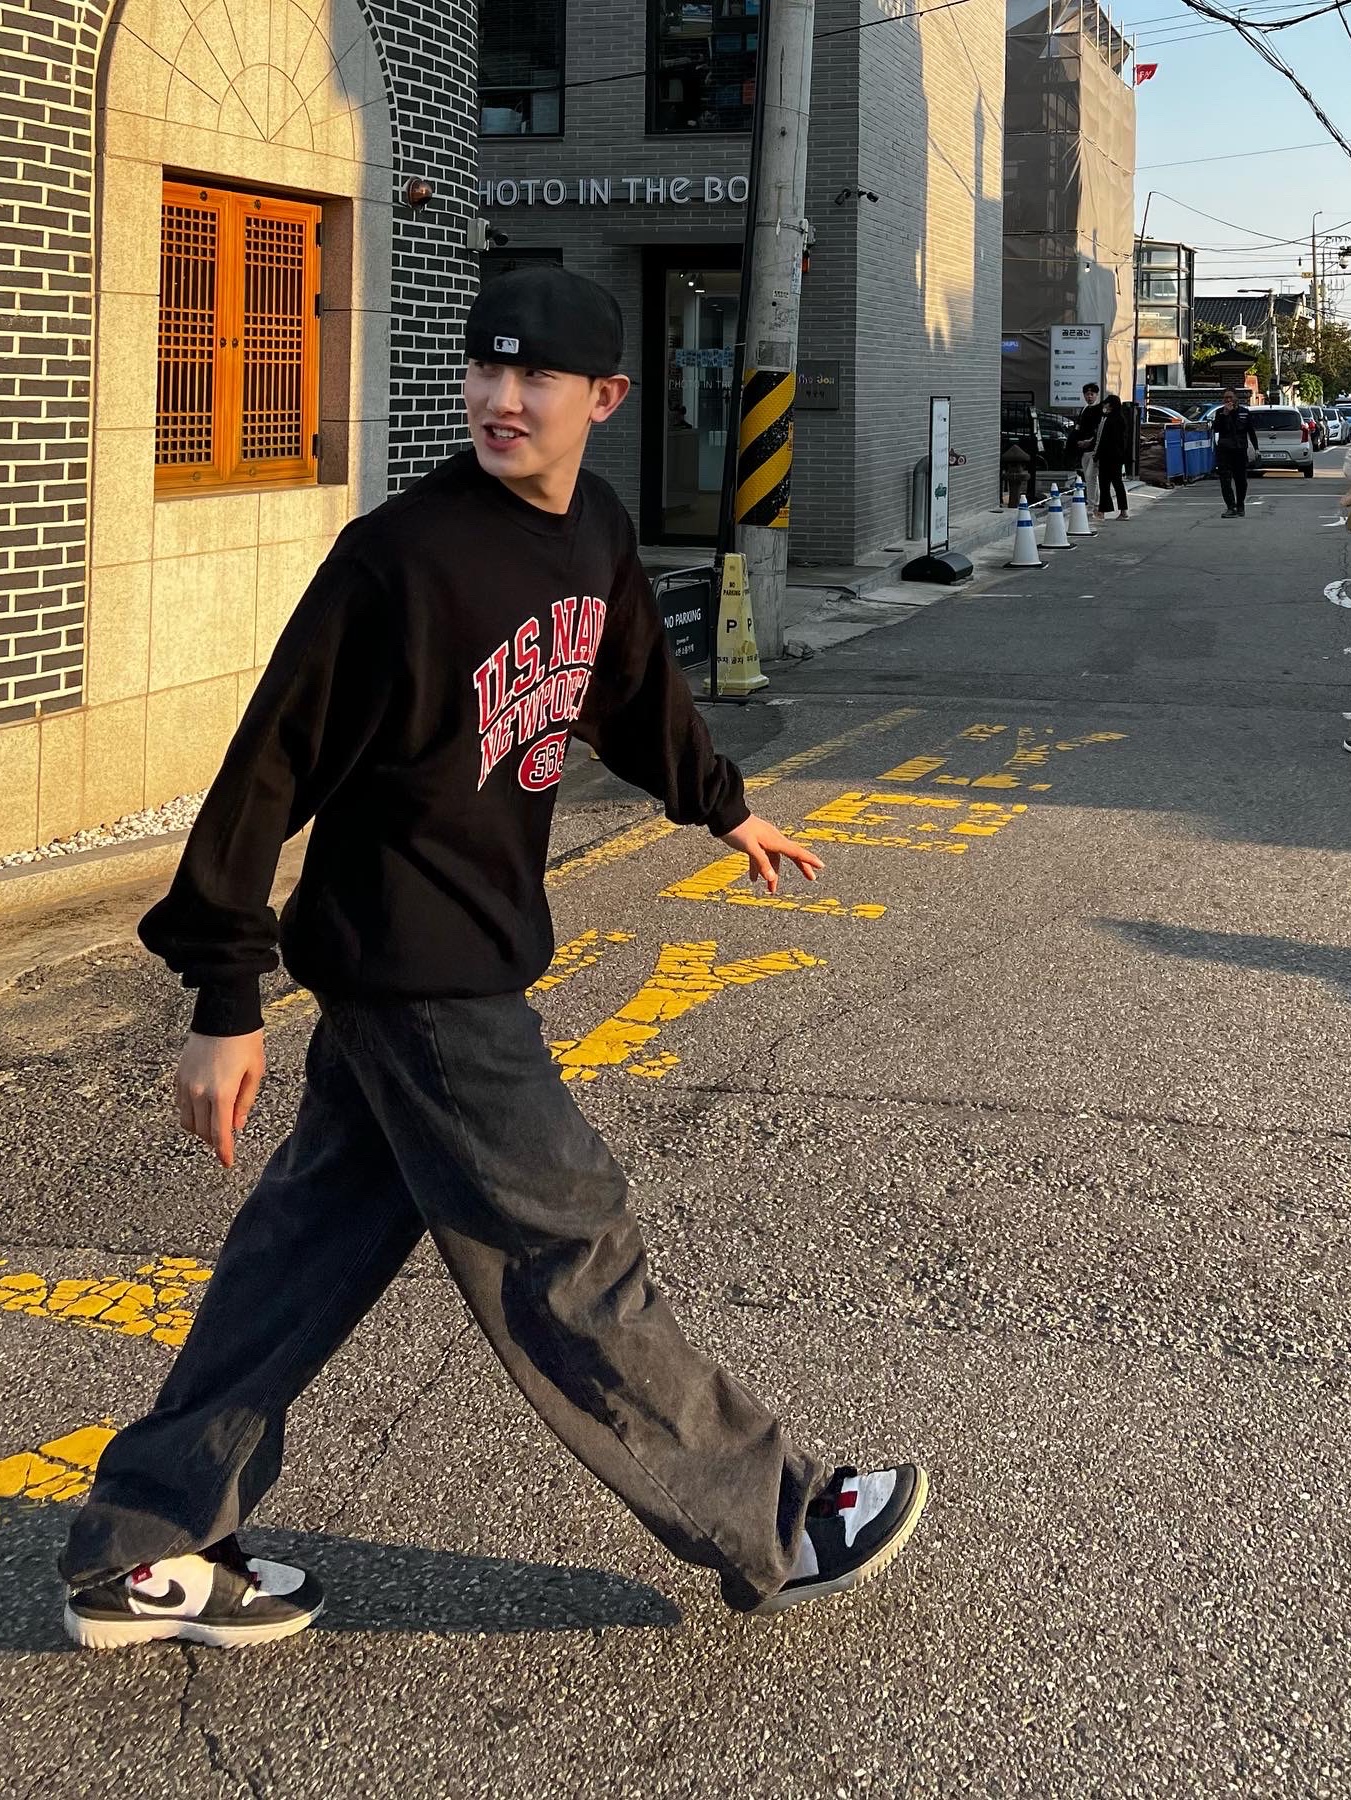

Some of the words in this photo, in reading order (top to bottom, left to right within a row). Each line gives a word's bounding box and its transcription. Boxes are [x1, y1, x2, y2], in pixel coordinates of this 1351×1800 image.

[478, 178, 567, 206] HOTO
[578, 178, 611, 205] IN
[704, 176, 749, 205] BO
[664, 615, 674, 629] NO
[675, 608, 702, 627] PARKING
[726, 619, 738, 633] P
[473, 616, 546, 735] U.S.
[548, 596, 607, 672] NAV
